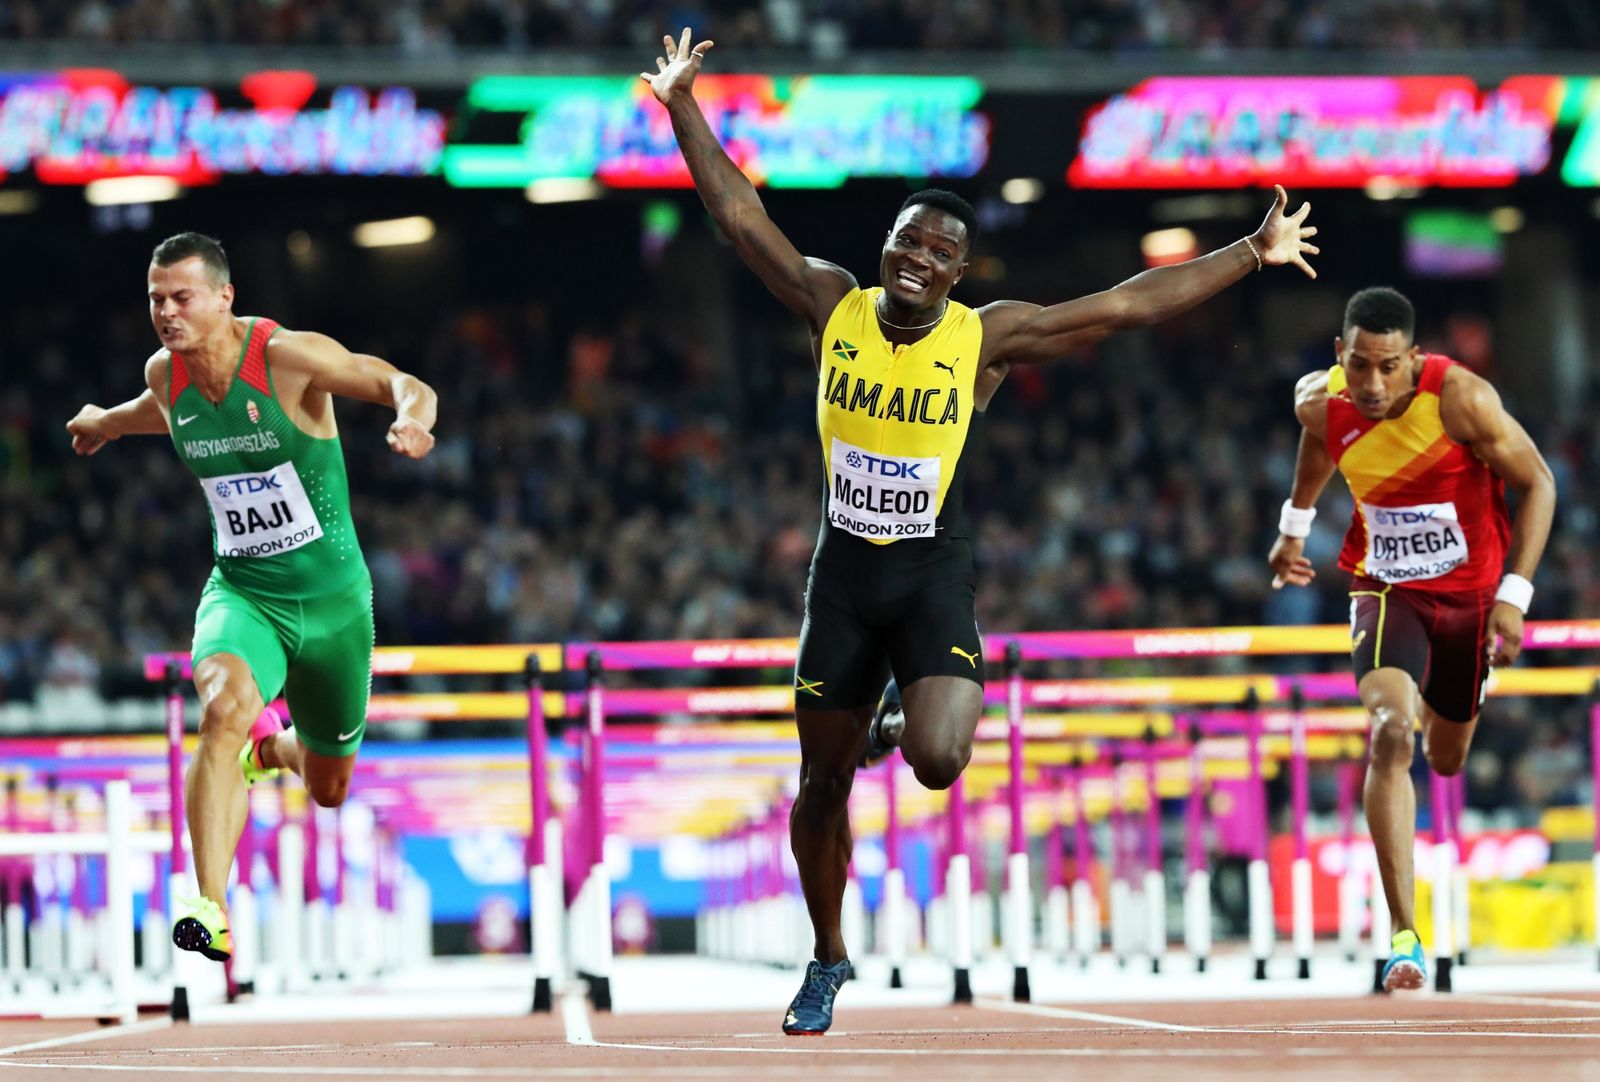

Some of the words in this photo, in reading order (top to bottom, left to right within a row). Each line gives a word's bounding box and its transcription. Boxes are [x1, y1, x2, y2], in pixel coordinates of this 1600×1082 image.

[824, 366, 958, 425] JAMAICA
[183, 427, 280, 459] MAGYARORSZÁG
[862, 454, 922, 480] TDK
[228, 473, 282, 495] TDK
[835, 473, 930, 515] McLEOD
[225, 500, 294, 536] BAJI
[831, 511, 892, 535] LONDON
[895, 523, 931, 535] 2017
[1386, 510, 1436, 526] TDK
[224, 539, 285, 558] LONDON
[284, 525, 315, 547] 2017
[1374, 526, 1459, 560] ORTEGA
